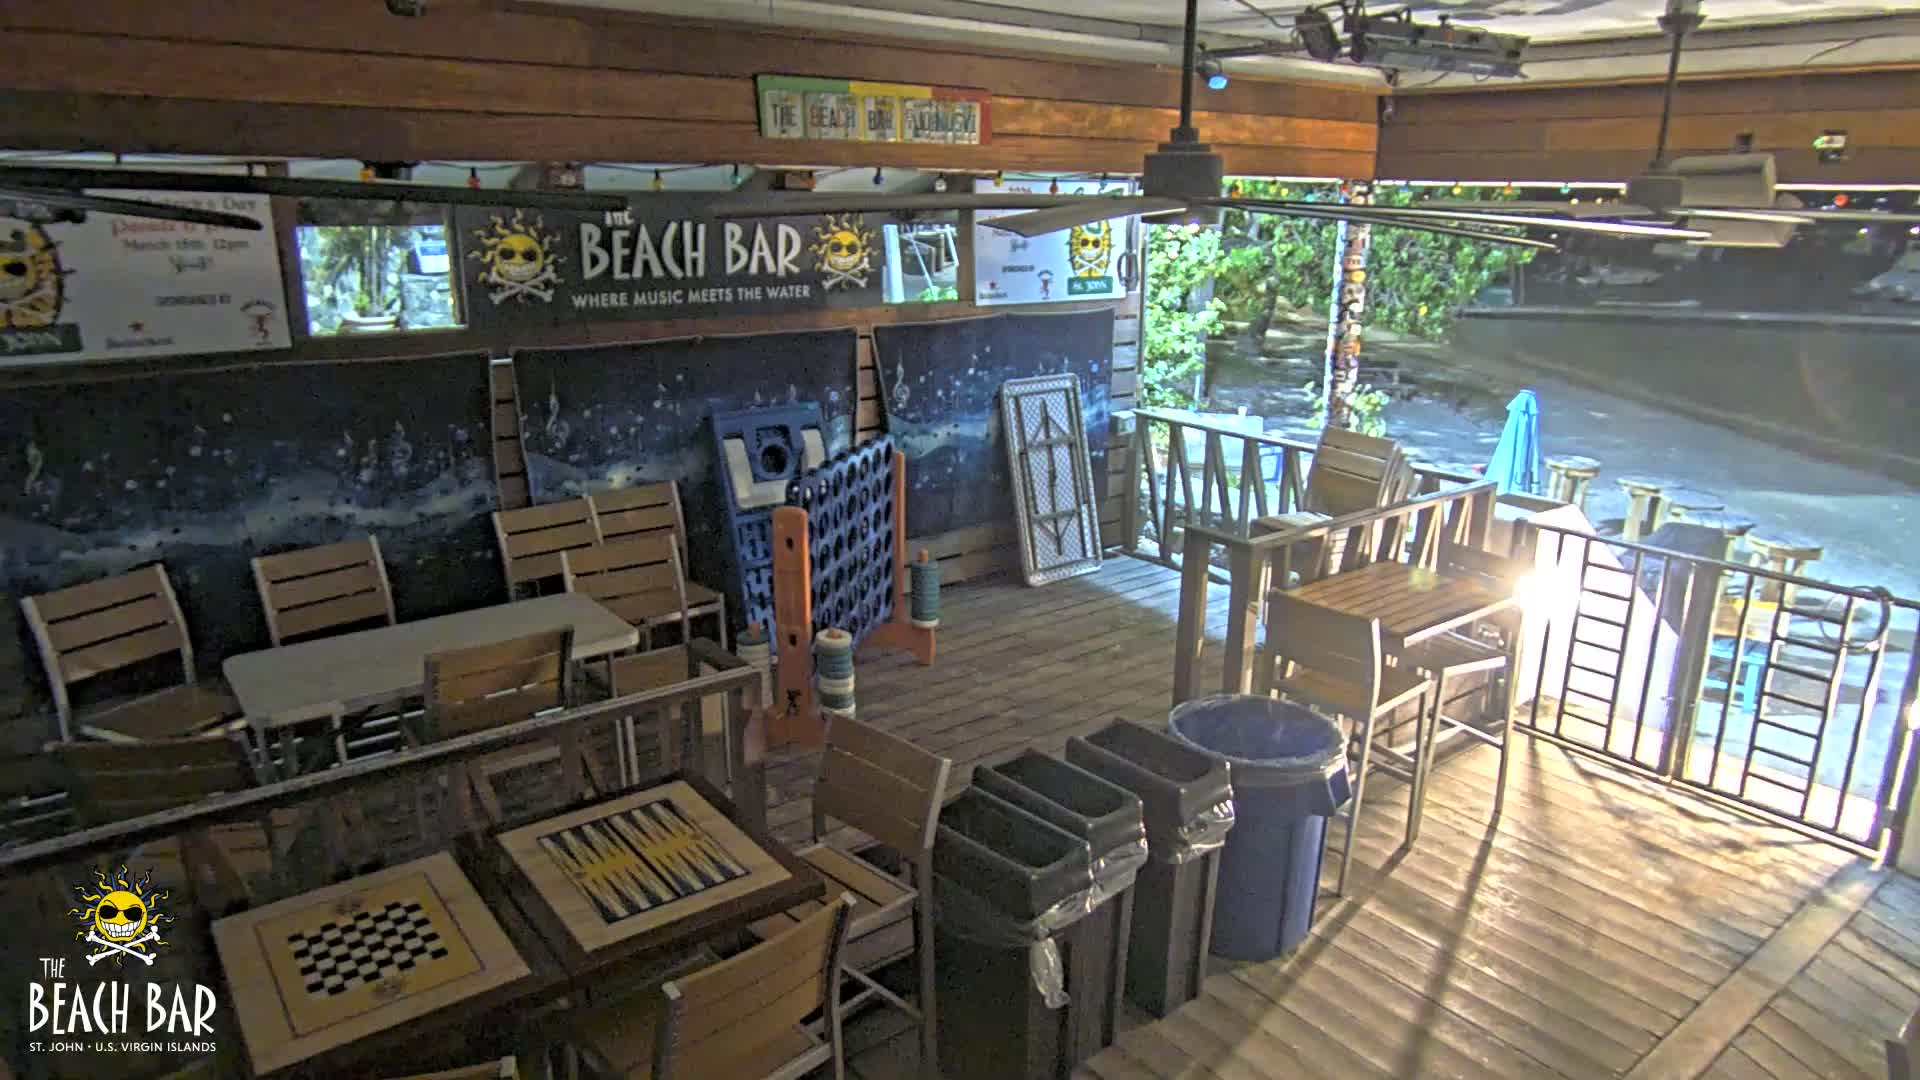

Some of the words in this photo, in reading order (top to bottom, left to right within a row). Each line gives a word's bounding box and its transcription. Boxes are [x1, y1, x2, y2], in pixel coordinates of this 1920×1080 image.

[580, 221, 706, 280] BEACH
[724, 222, 801, 277] BAR
[572, 293, 628, 308] WHERE
[633, 290, 683, 305] MUSIC
[688, 288, 733, 303] MEETS
[737, 286, 762, 300] THE
[766, 284, 811, 299] WATER
